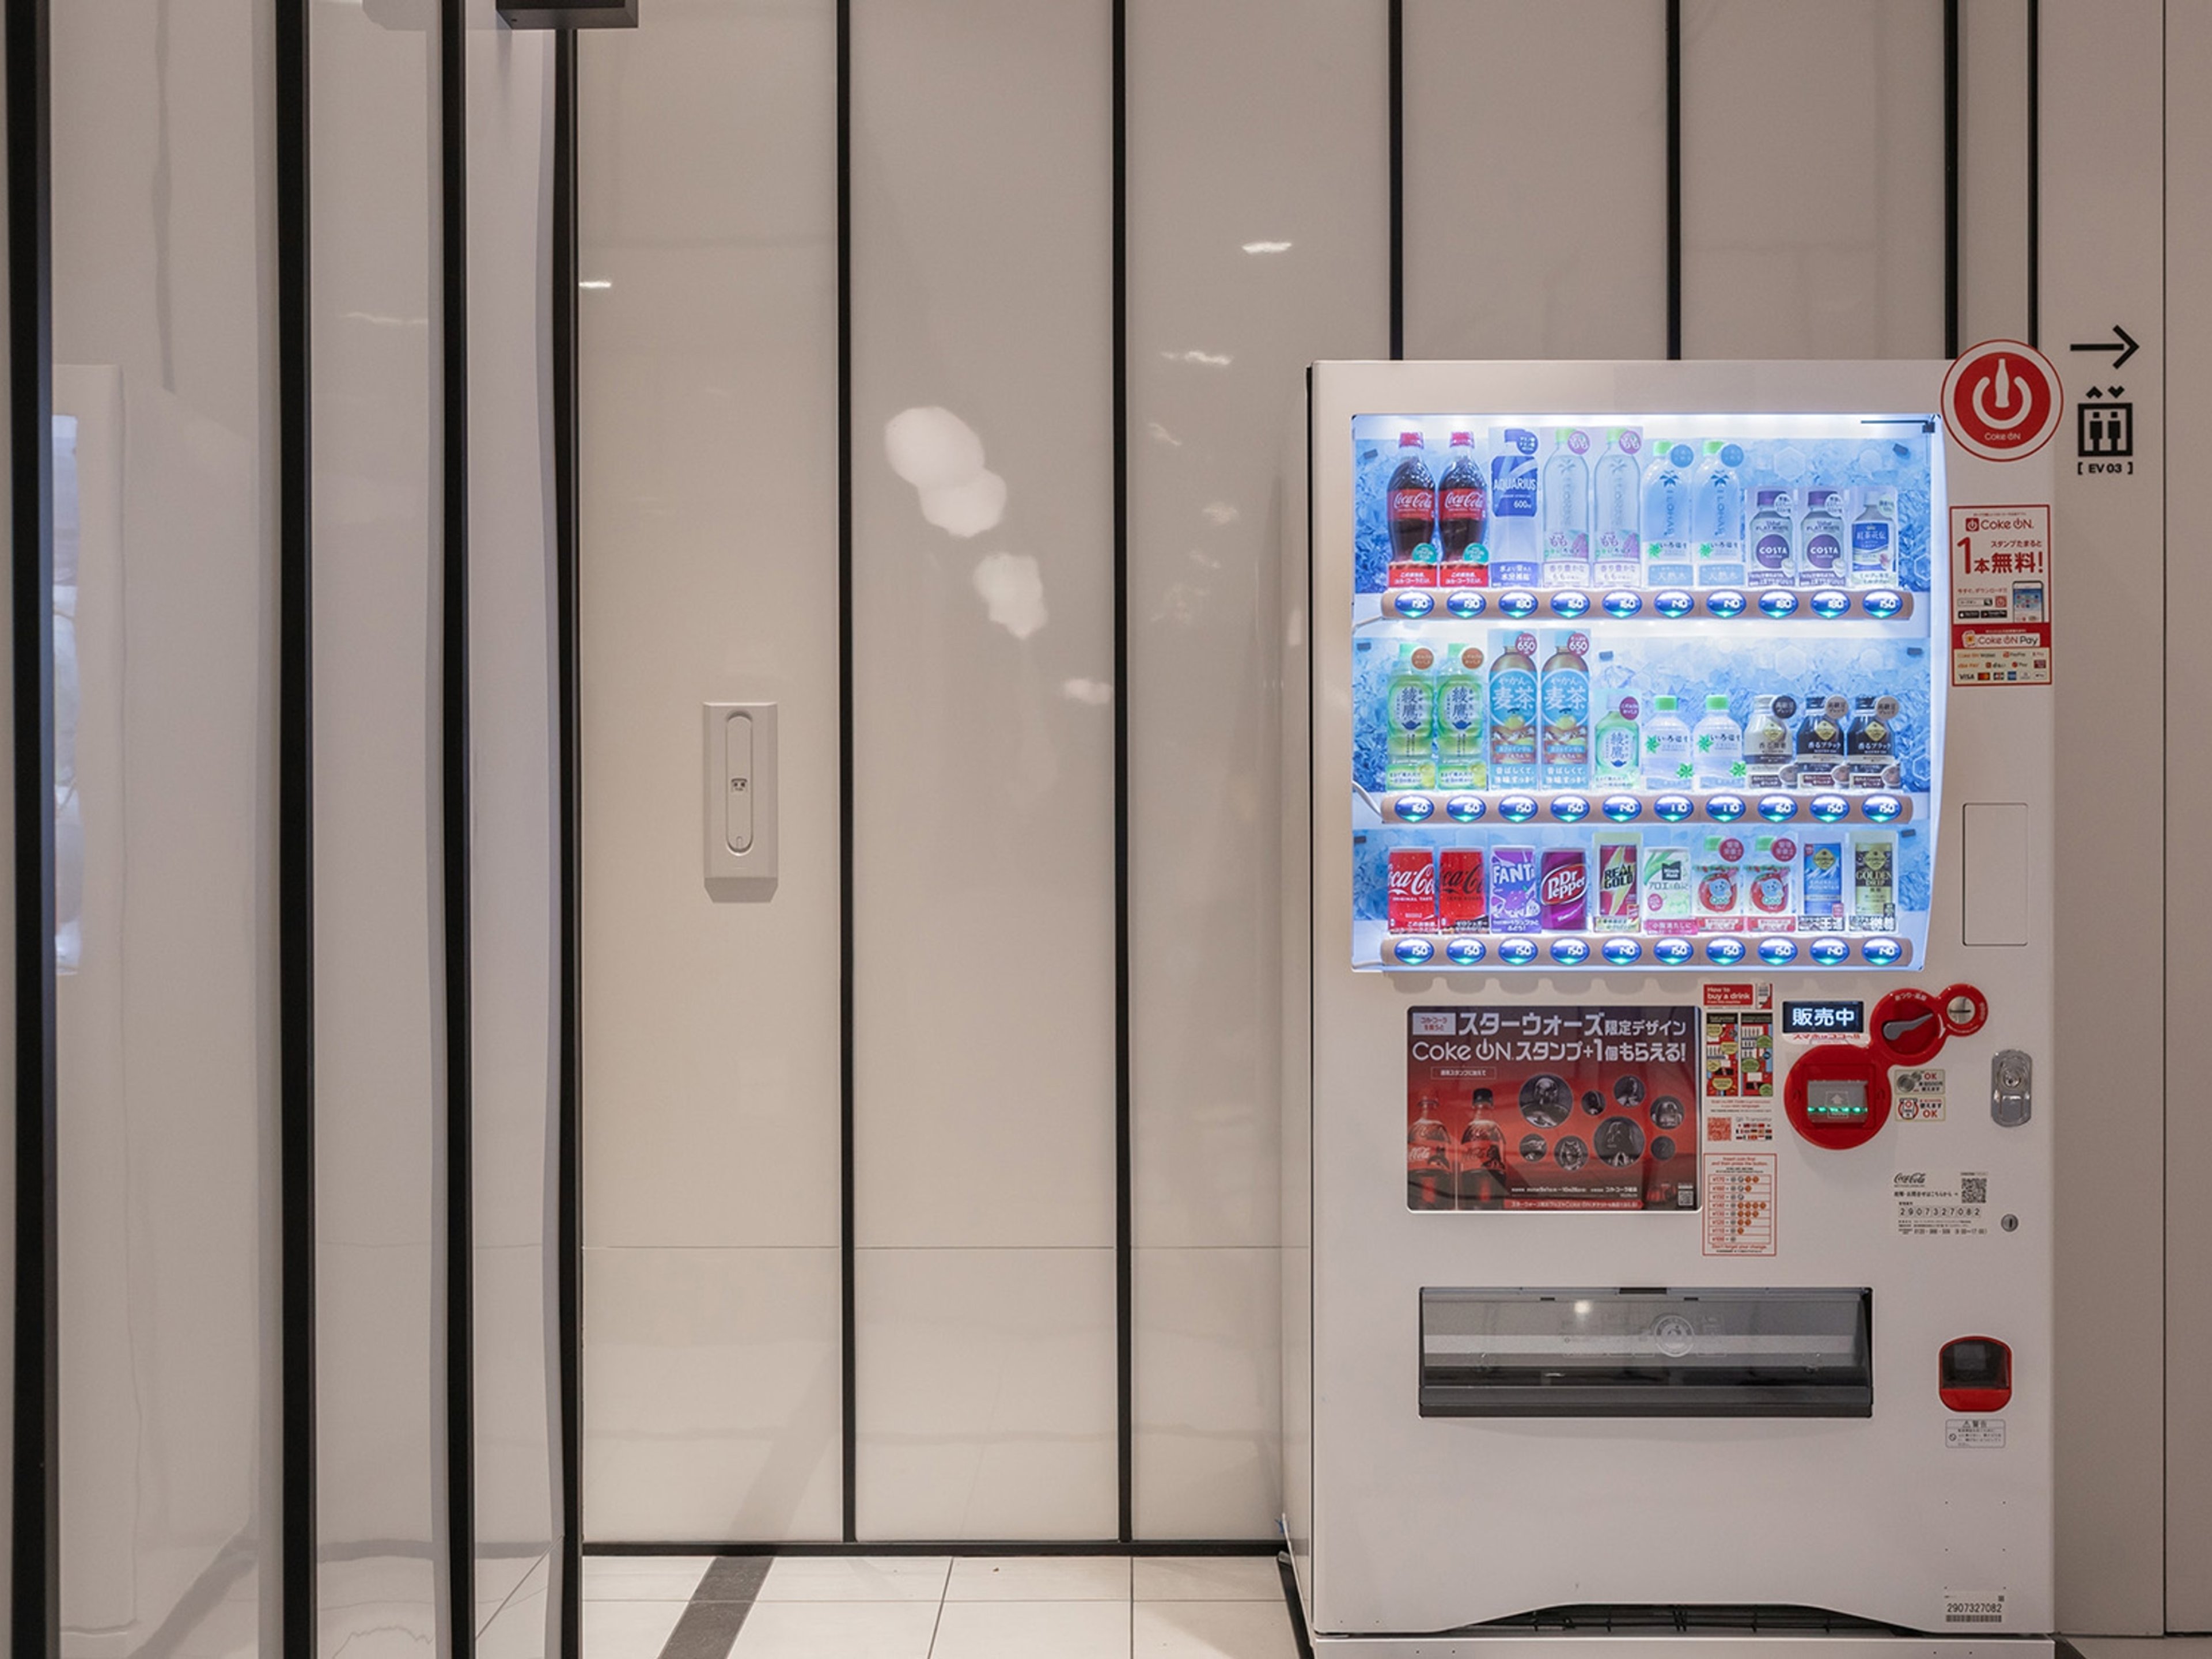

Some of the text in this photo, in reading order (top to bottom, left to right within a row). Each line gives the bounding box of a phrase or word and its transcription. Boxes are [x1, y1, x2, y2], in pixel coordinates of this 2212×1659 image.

[1493, 479, 1536, 490] AQUARIUS
[1393, 491, 1432, 509] Coca-Cola
[1445, 491, 1483, 509] Coca-Cola
[1981, 520, 2011, 530] Coke
[1991, 540, 2042, 548] スタンプたまると
[1957, 537, 2044, 574] 1本無料!
[1517, 642, 1536, 652] 650
[1569, 642, 1588, 652] 650
[1978, 636, 2002, 644] Coke
[2020, 636, 2038, 645] Pay
[1402, 686, 1418, 720] 綾鷹
[1452, 686, 1469, 720] 綾鷹
[1492, 685, 1536, 710] 麦茶
[1544, 685, 1587, 710] 麦茶
[1559, 869, 1577, 882] Dr
[1604, 864, 1634, 878] REAL
[1856, 871, 1892, 880] GOLDEN
[1548, 877, 1585, 900] Pepper
[1604, 874, 1634, 889] GOLD
[1459, 1012, 1686, 1036] スターウォーズ限定デザイン
[1792, 1007, 1855, 1027] 販売中
[1412, 1041, 1471, 1060] Coke
[1923, 1109, 1938, 1118] OK
[1893, 1172, 1926, 1184] Coca-Cola
[1900, 1208, 1980, 1216] 2907327082
[1946, 1603, 2002, 1613] 2907327082
